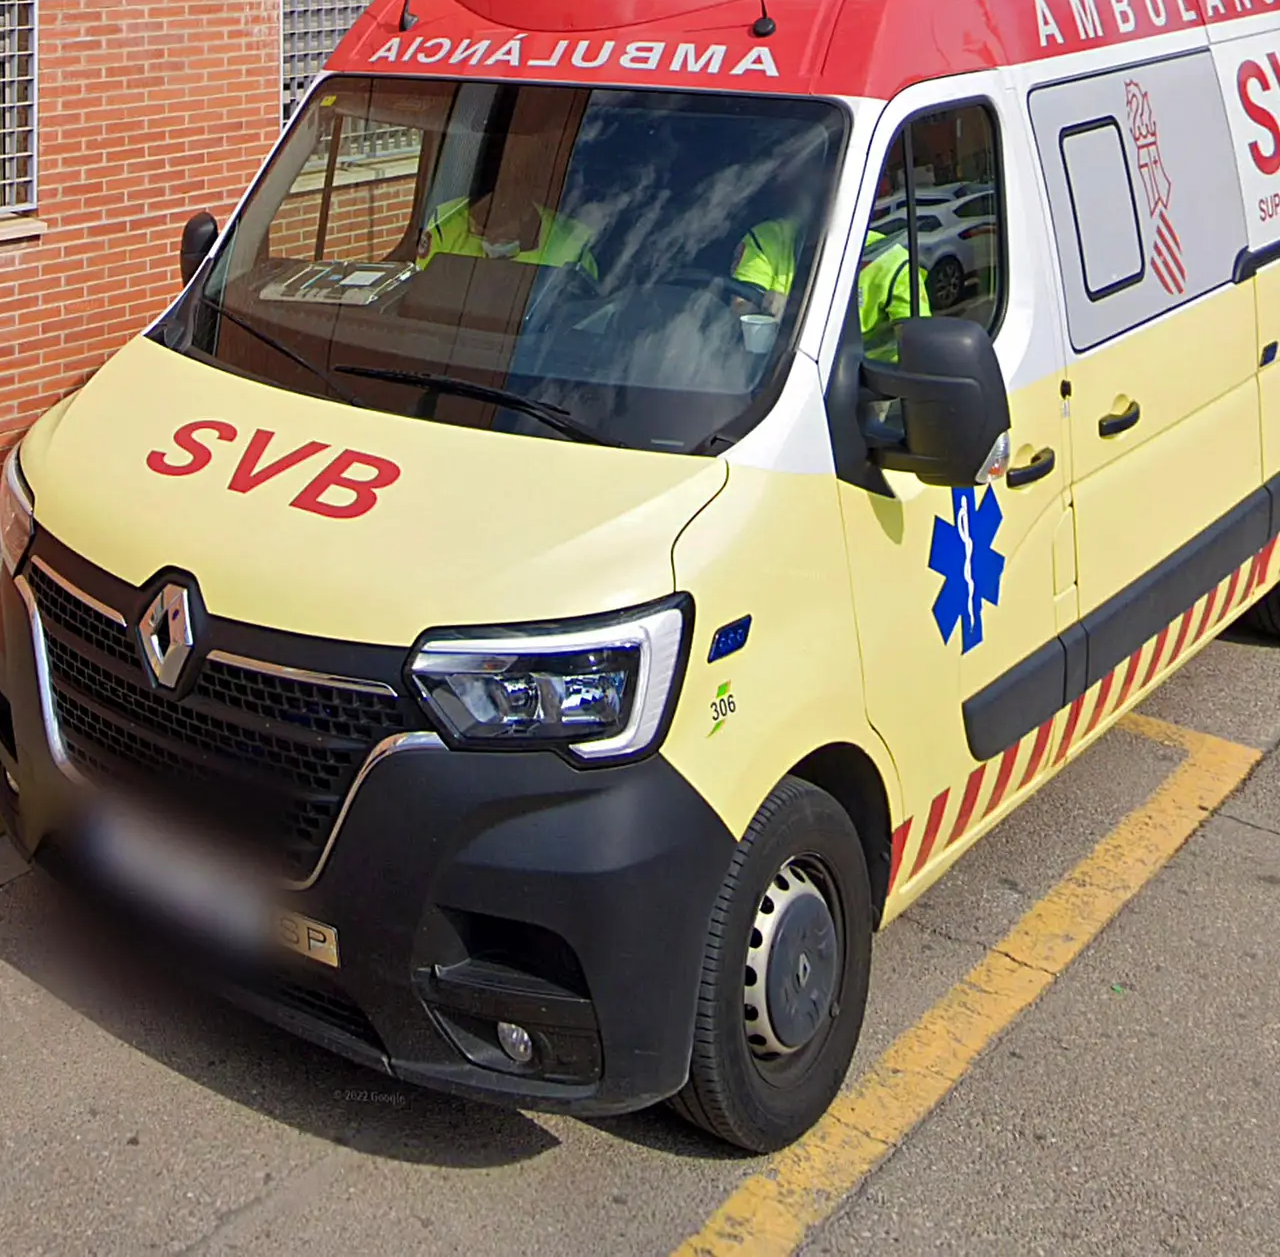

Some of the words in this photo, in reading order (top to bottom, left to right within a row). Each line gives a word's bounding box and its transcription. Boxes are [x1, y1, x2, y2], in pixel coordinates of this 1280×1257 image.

[145, 419, 402, 521] SVB
[710, 693, 737, 721] 306
[280, 916, 328, 951] SP
